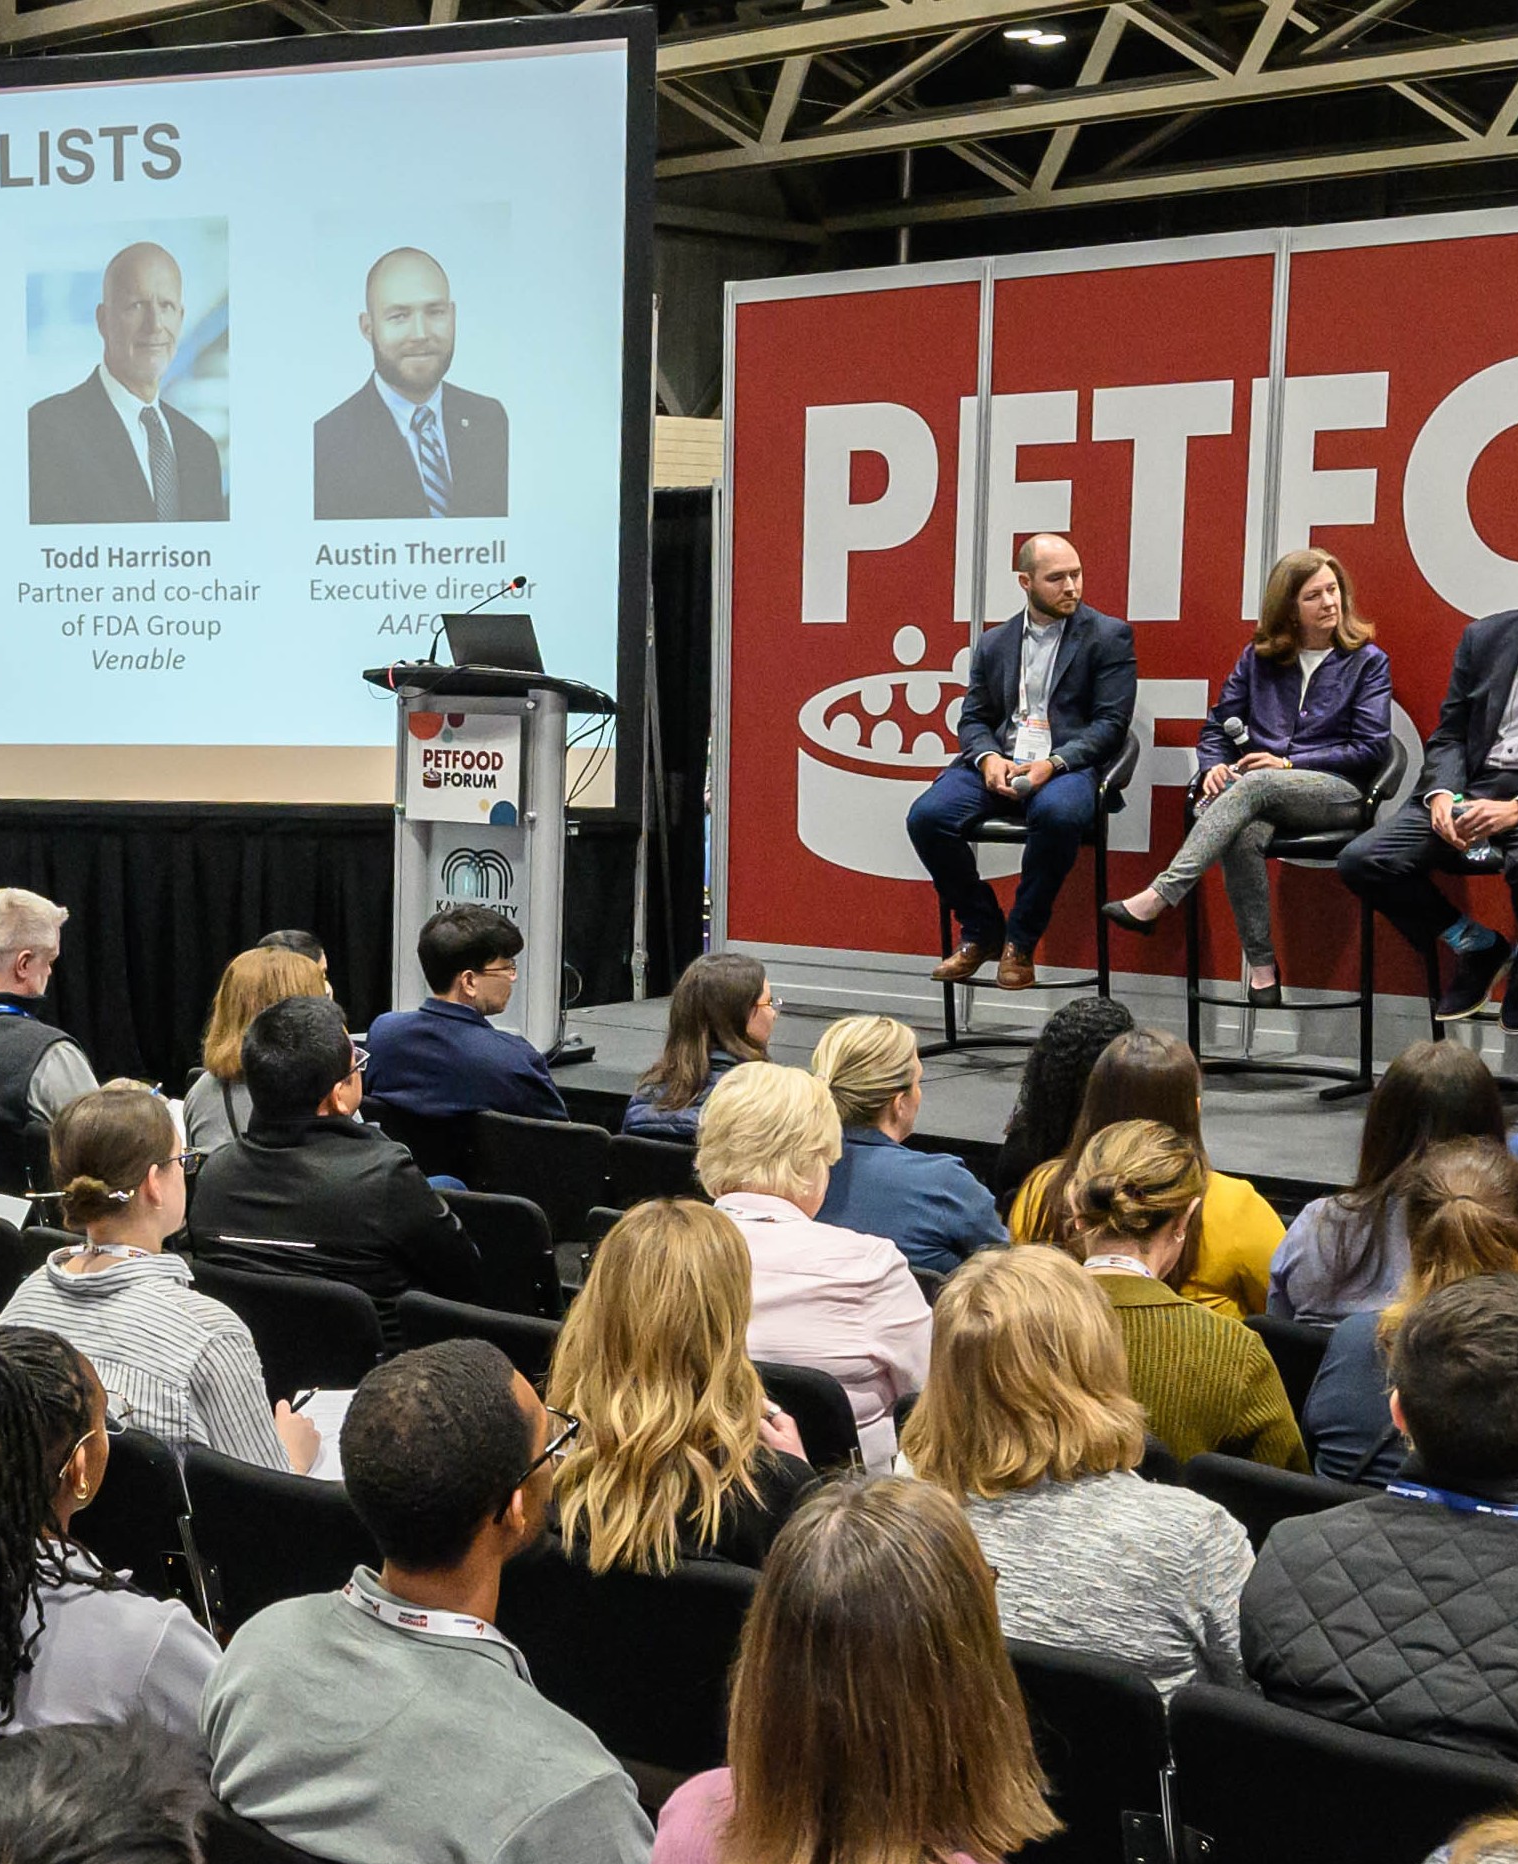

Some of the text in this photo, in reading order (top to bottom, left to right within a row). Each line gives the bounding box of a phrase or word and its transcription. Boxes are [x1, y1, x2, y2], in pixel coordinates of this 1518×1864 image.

[41, 545, 211, 569] Todd Harrison
[315, 540, 506, 566] Austin Therrell
[18, 578, 261, 604] Partner and co-chair
[310, 578, 432, 601] Executive
[62, 613, 222, 641] of FDA Group
[92, 647, 186, 671] Venable
[423, 749, 504, 772] PETFOOD
[443, 772, 497, 790] FORUM
